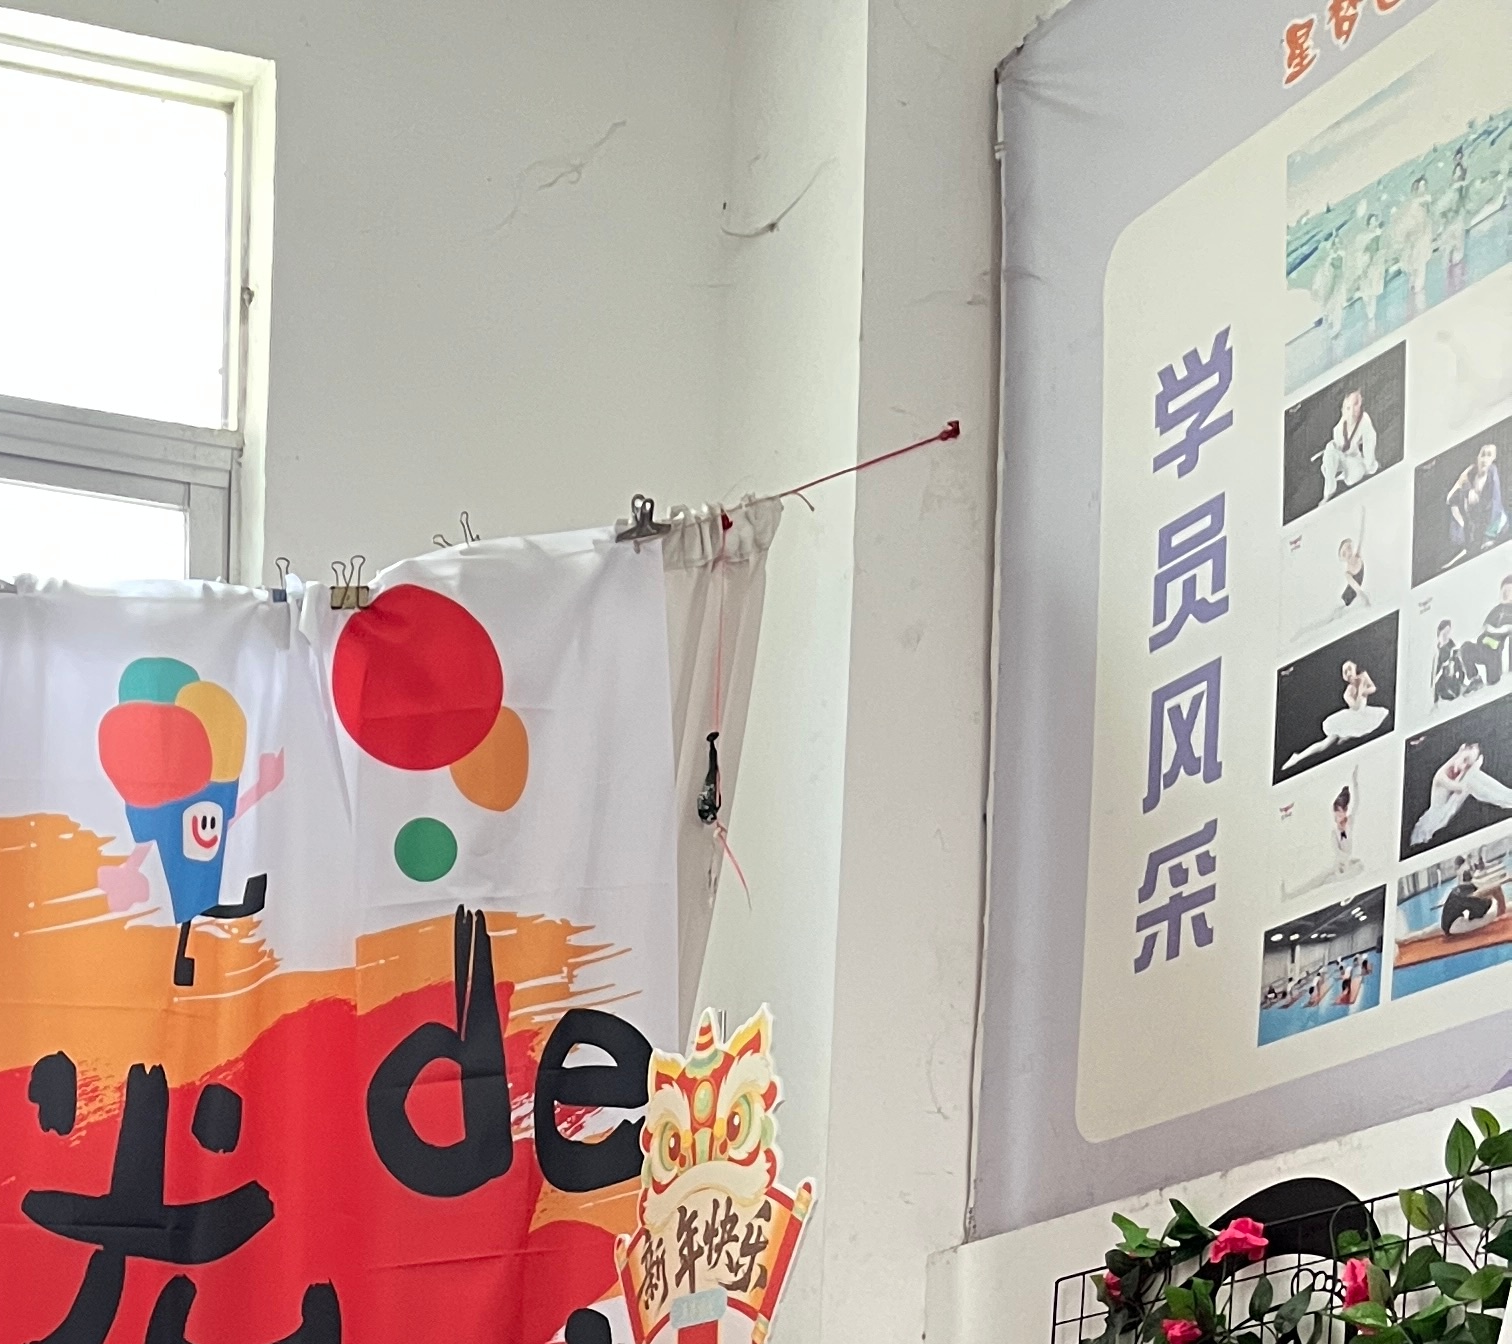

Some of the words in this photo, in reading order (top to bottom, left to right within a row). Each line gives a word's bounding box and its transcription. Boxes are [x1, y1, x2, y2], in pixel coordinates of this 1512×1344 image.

[1133, 323, 1234, 975] 学员风采
[638, 1196, 773, 1312] 新年快乐
